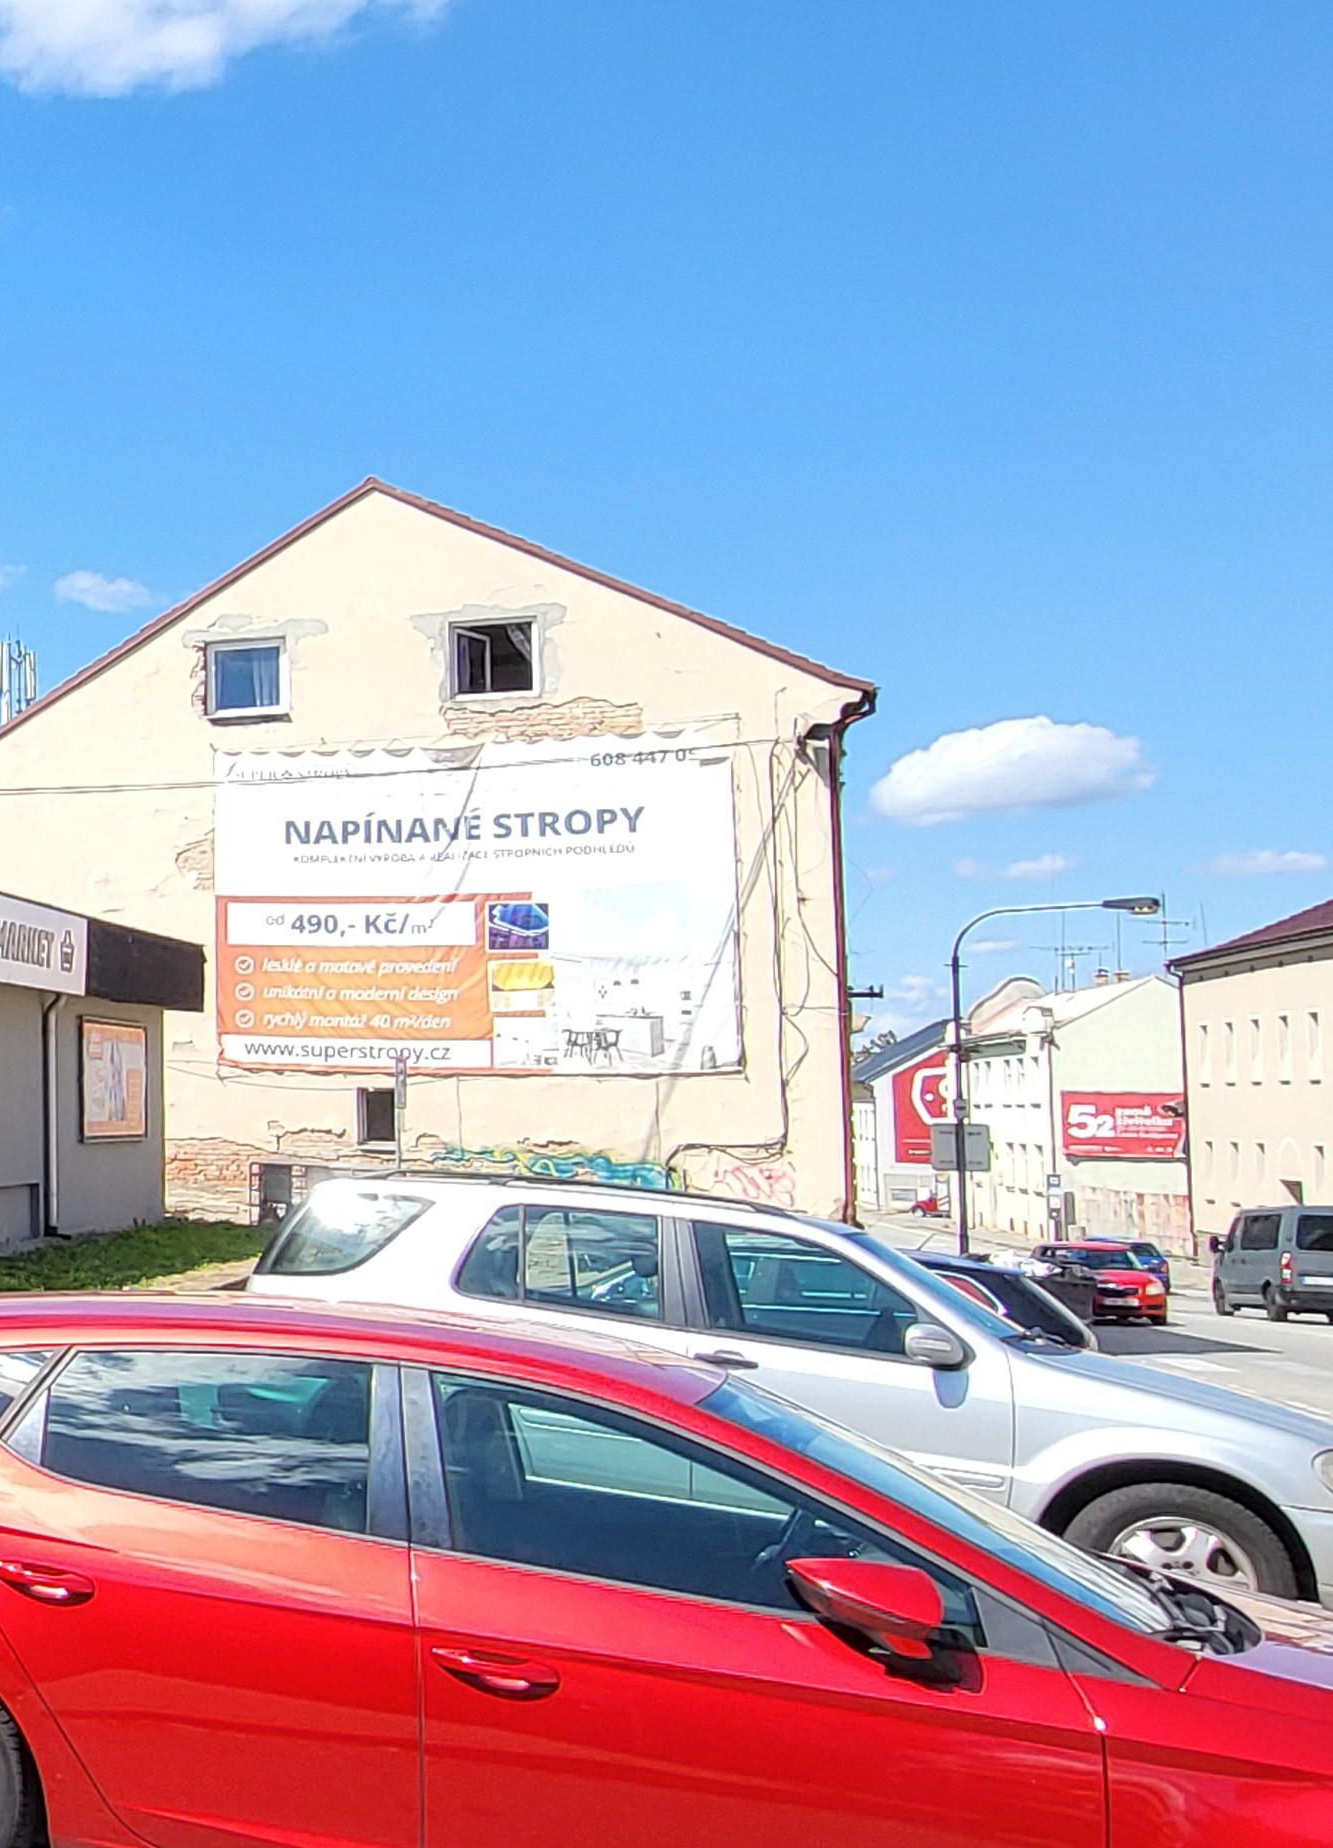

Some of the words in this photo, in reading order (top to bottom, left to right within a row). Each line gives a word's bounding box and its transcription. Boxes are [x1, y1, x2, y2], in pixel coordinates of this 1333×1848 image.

[590, 752, 626, 767] 608
[285, 807, 482, 845] NAPÍNANÉ
[493, 806, 646, 840] STROPY
[291, 913, 356, 938] 490,-
[262, 957, 302, 973] lesklé
[305, 961, 316, 973] a
[319, 958, 377, 974] matové
[377, 956, 459, 977] provedení
[263, 985, 325, 1001] unikátní
[326, 989, 341, 1001] a
[341, 985, 406, 1001] moderní
[408, 985, 460, 1005] design
[262, 1013, 307, 1030] rychlý
[310, 1014, 367, 1030] montáž
[370, 1015, 391, 1029] 40
[244, 1041, 452, 1064] www.superstropy.cz
[1066, 1103, 1117, 1139] 52
